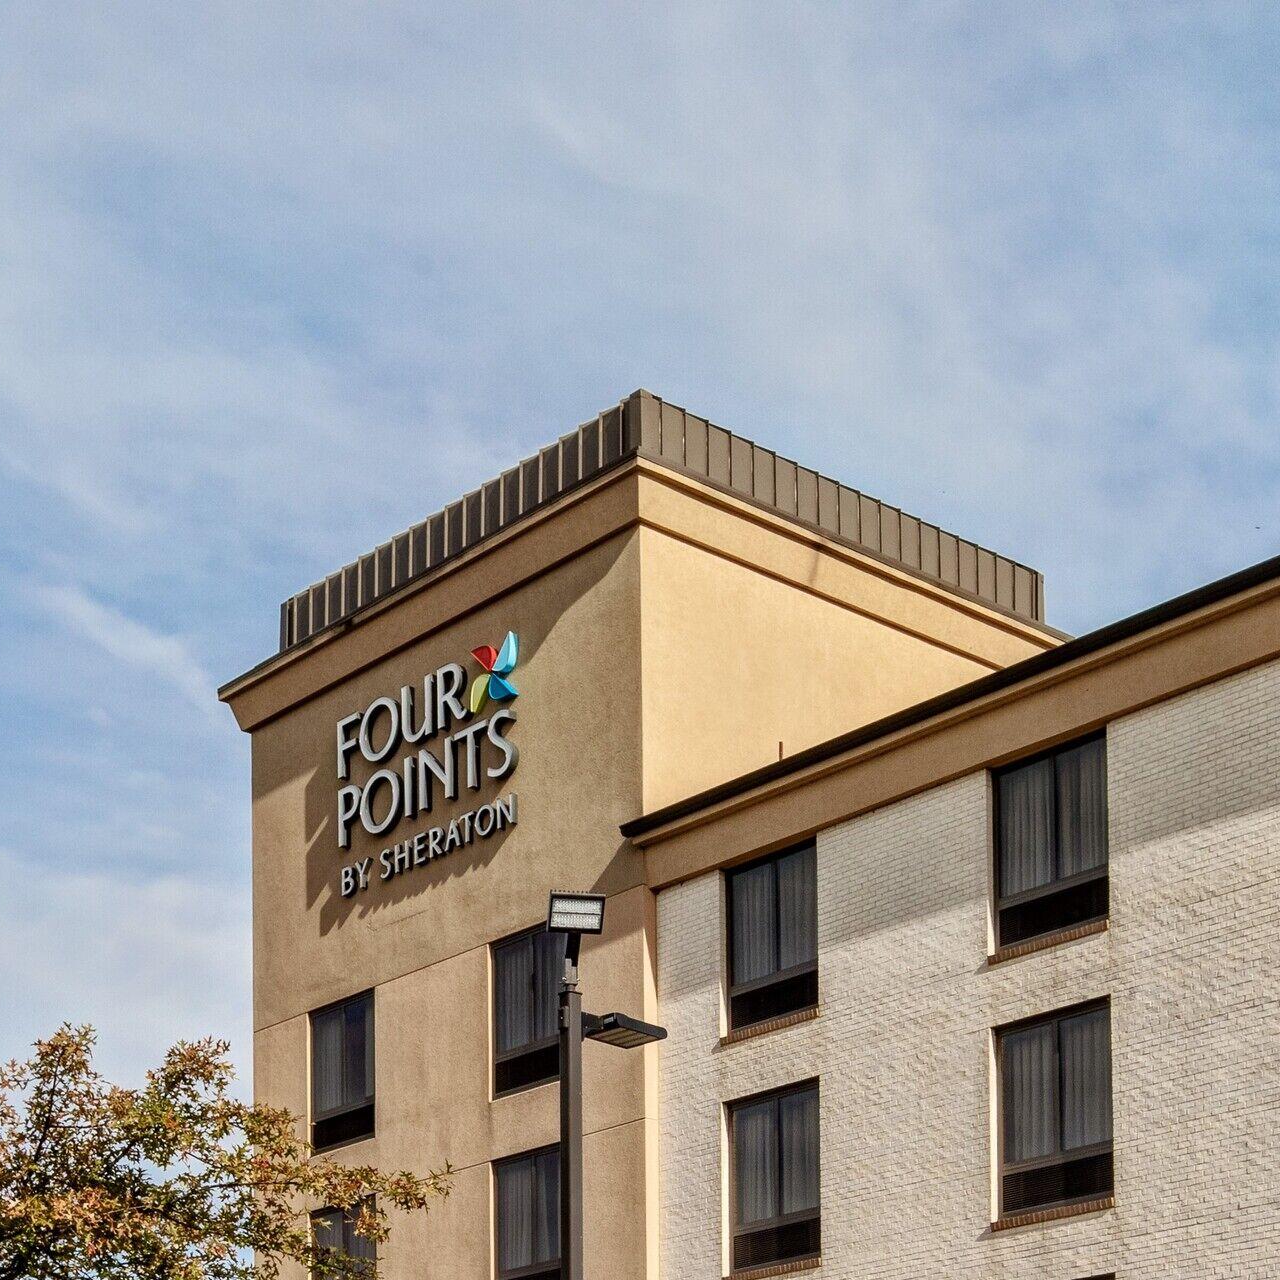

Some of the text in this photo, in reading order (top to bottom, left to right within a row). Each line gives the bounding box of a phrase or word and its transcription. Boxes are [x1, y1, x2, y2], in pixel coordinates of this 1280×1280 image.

[336, 662, 468, 779] FOUR
[337, 709, 517, 848] POINTS
[341, 792, 517, 897] BY SHERATON
